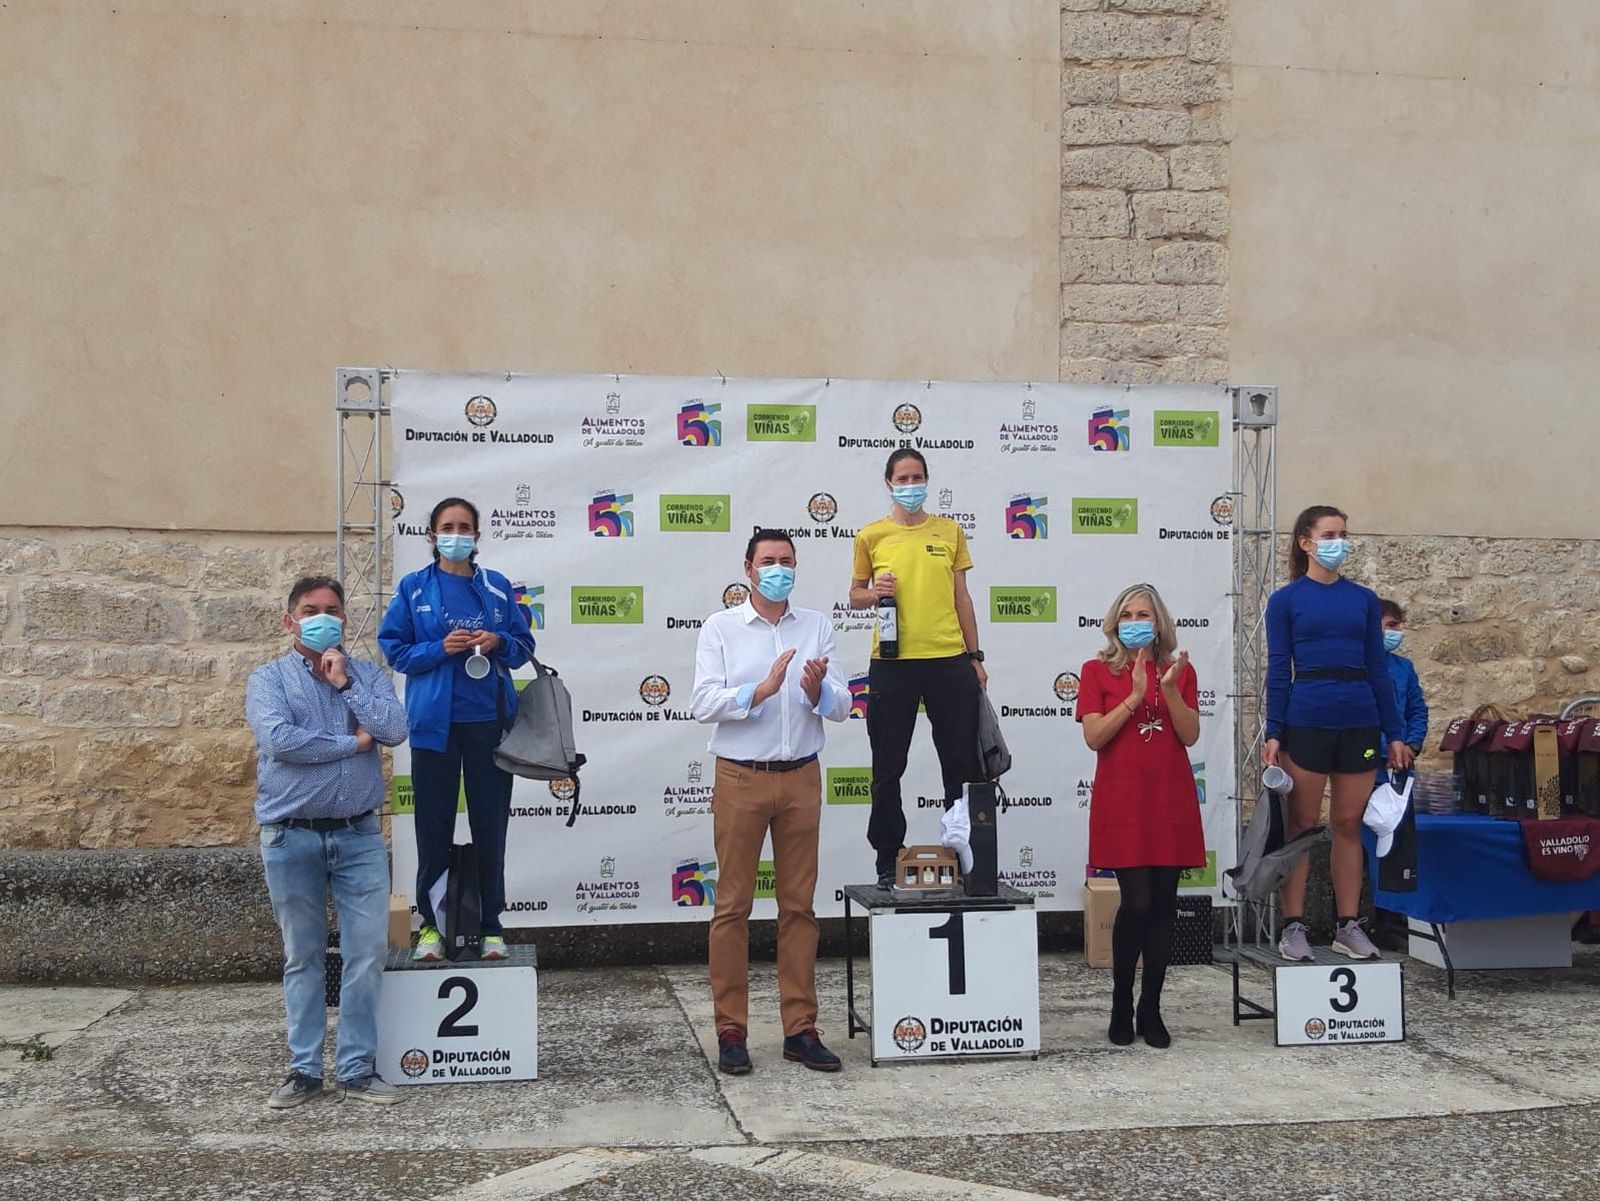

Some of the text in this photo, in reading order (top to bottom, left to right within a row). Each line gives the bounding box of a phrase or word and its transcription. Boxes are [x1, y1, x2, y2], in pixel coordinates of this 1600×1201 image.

[582, 416, 645, 427] ALIMENTOS
[753, 413, 790, 422] CORRIENDO
[595, 427, 646, 436] VALLADOLID
[754, 421, 790, 434] VIÑAS
[1000, 423, 1058, 433] ALIMENTOS
[1161, 427, 1194, 439] VIÑAS
[405, 428, 554, 444] DIPUTACIÓN DE VALLADOLID
[1013, 433, 1058, 441] VALLADOLID
[838, 436, 974, 449] DIPUTACIÓN DE VALLADOLID
[491, 508, 556, 519] ALIMENTOS
[666, 503, 704, 512] CORRIENDO
[505, 519, 556, 527] VALLADOLID
[667, 511, 704, 525] VIÑAS
[1079, 514, 1113, 527] VIÑAS
[815, 529, 828, 538] DE
[1159, 528, 1229, 540] DIPUTACIÓN DE
[996, 595, 1031, 603] CORRIENDO
[579, 603, 616, 616] VIÑAS
[997, 602, 1031, 615] VIÑAS
[666, 617, 703, 629] DIPUTA
[582, 709, 643, 722] DIPUTACIÓN
[647, 711, 660, 721] DE
[1001, 705, 1073, 718] DIPUTACIÓN DE
[833, 776, 869, 784] CORRIENDO
[834, 784, 869, 797] VIÑAS
[509, 805, 552, 817] UTACIÓN
[556, 806, 570, 816] DE
[1540, 835, 1590, 847] VALLADOLID
[1541, 845, 1574, 856] ES VINO
[997, 870, 1056, 880] ALIMENTOS
[576, 880, 640, 891] ALIMENTOS
[1010, 880, 1057, 888] VALLADOLID
[589, 891, 640, 900] VALLADOLID
[504, 901, 548, 912] LADOLID
[929, 911, 966, 995] 1
[1329, 967, 1358, 1013] 3
[437, 976, 479, 1038] 2
[930, 1015, 1023, 1035] DIPUTACIÓN
[1328, 1017, 1385, 1029] DIPUTACIÓN
[1340, 1030, 1386, 1040] VALLADOLID
[930, 1037, 1024, 1051] DE VALLADOLID
[432, 1048, 511, 1064] DIPUTACIÓN
[432, 1065, 512, 1078] DE VALLADOLID
